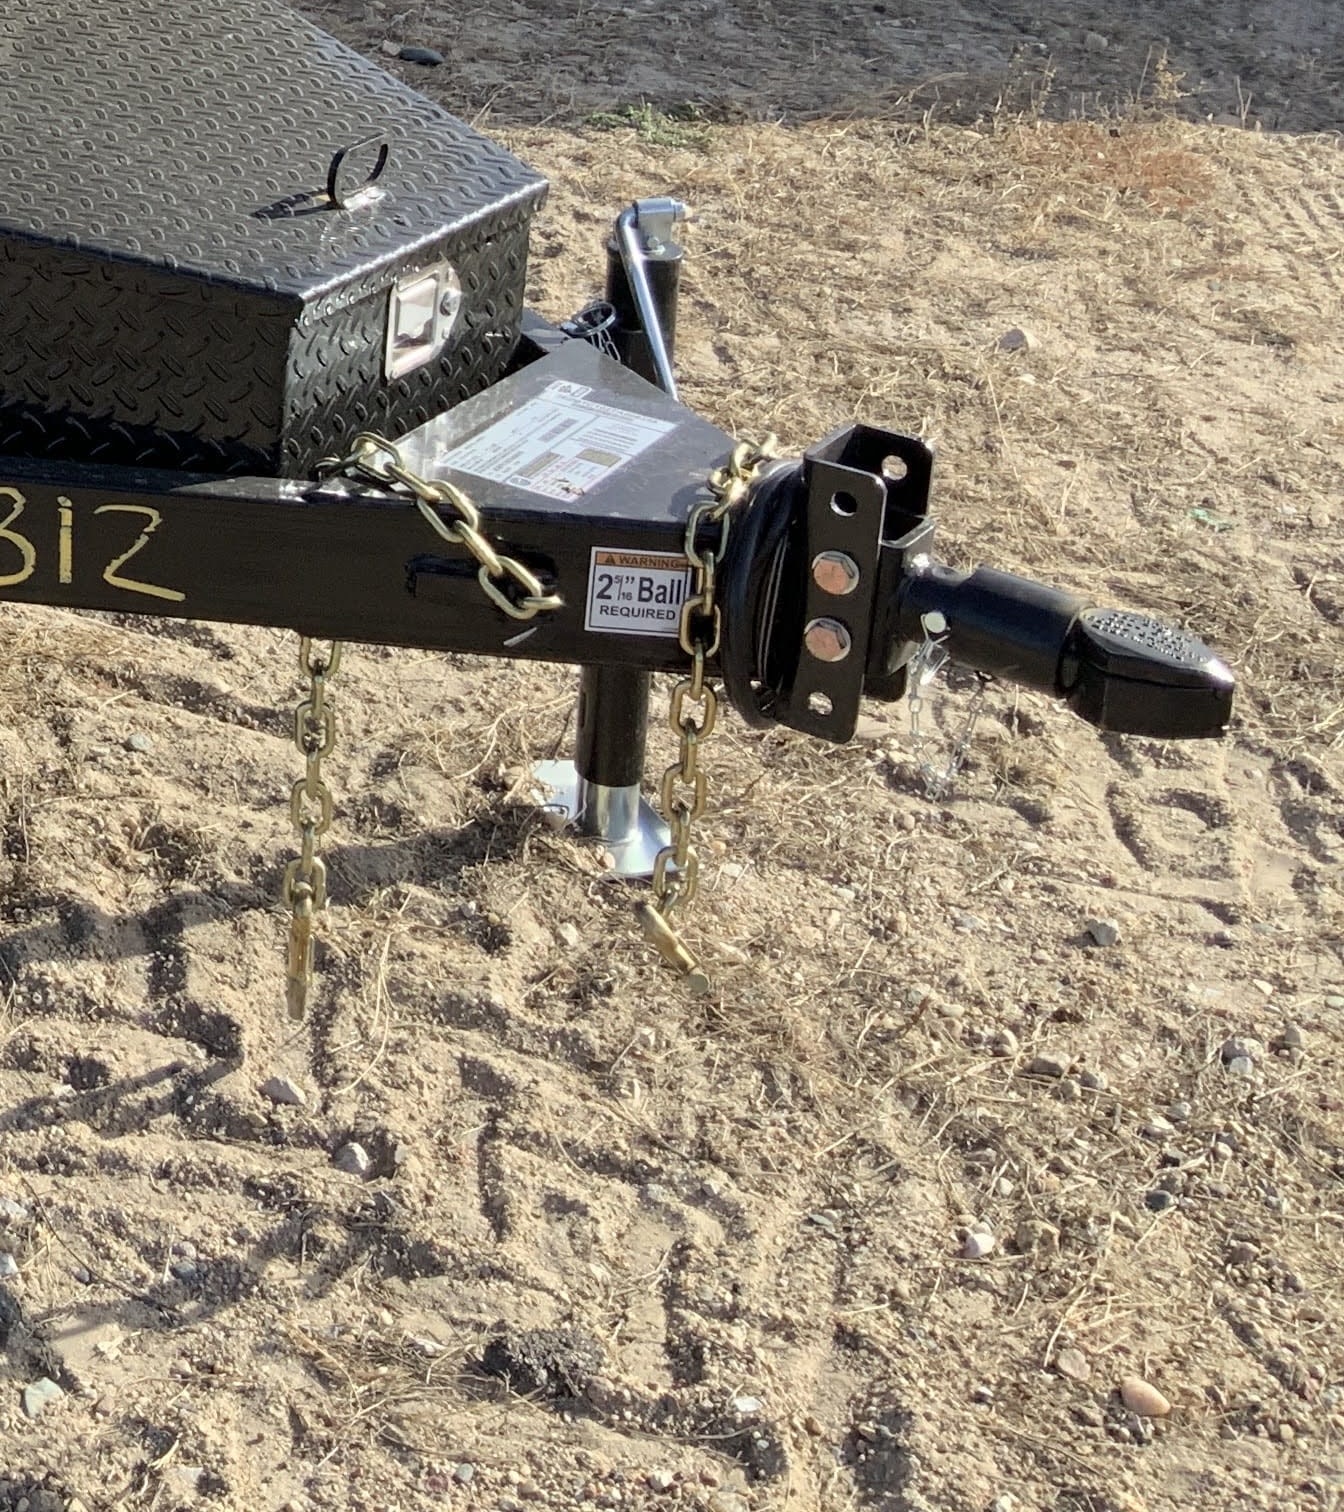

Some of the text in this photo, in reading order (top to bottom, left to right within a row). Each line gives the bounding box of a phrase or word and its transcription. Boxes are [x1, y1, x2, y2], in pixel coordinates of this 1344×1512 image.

[618, 555, 679, 568] WARNING
[637, 576, 682, 605] Ball
[599, 604, 676, 621] REQUIRED
